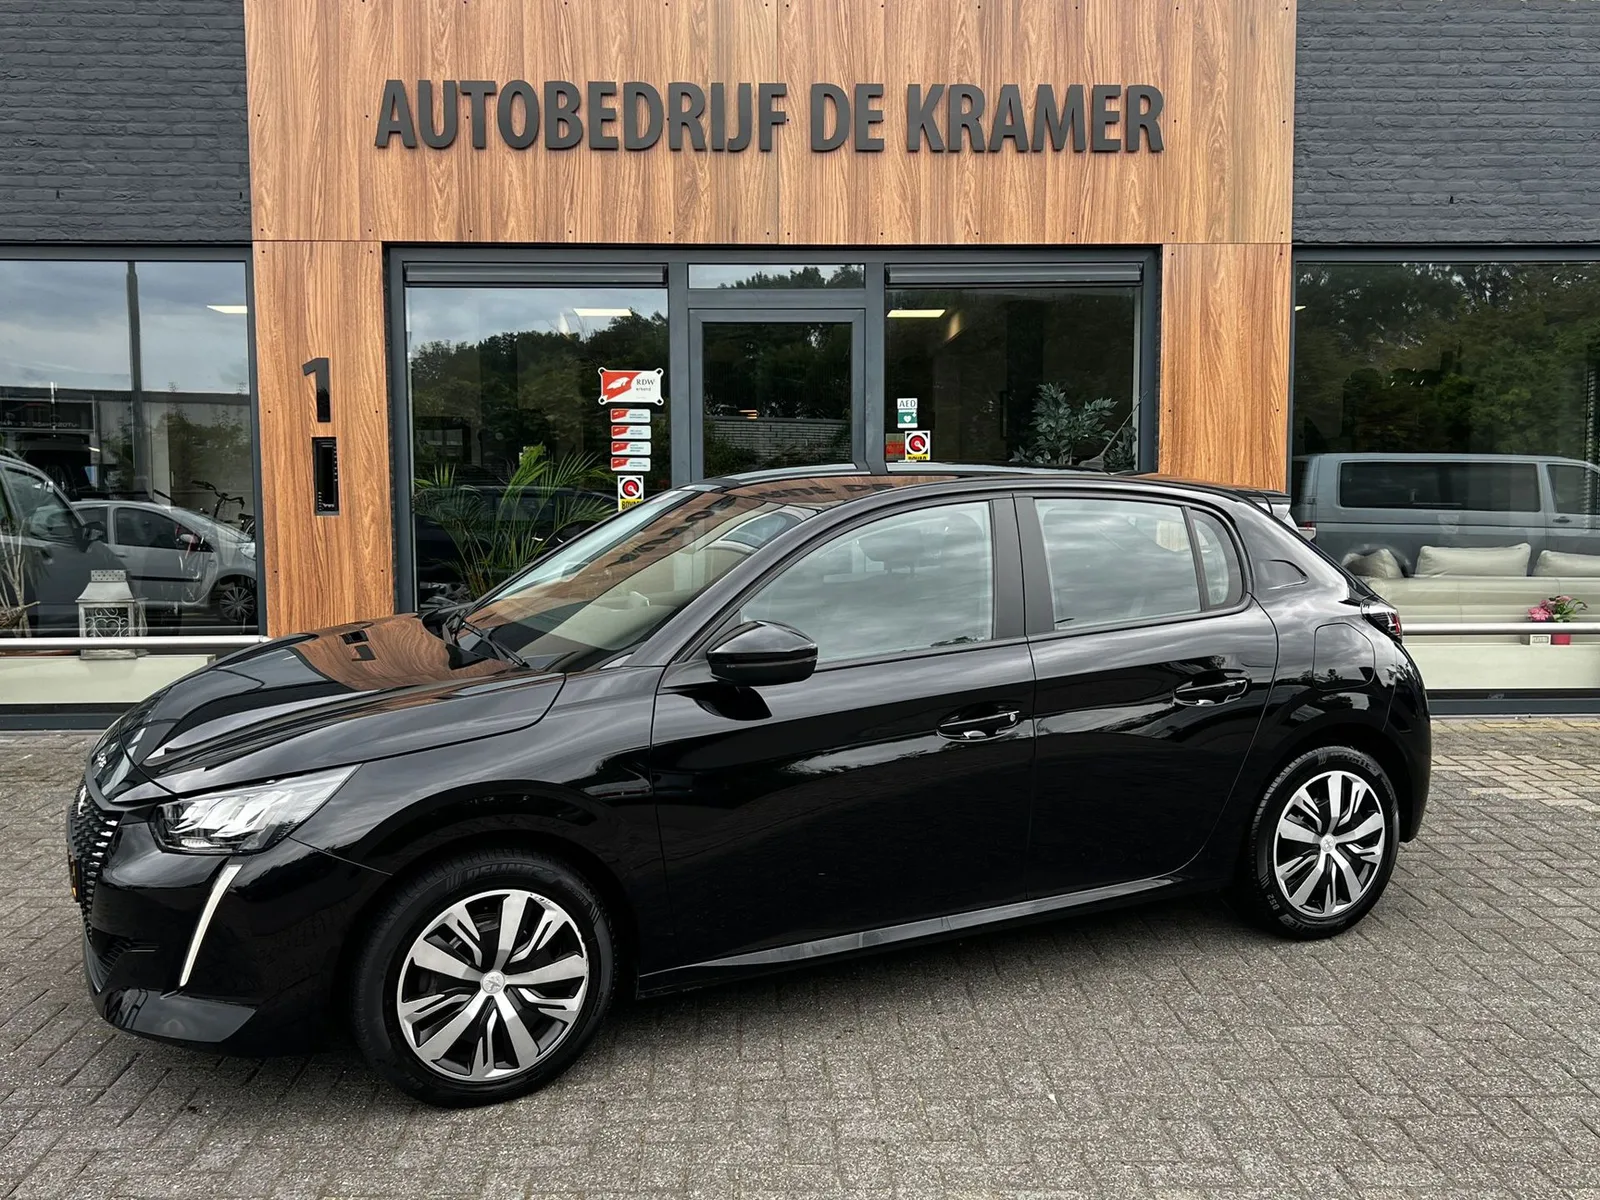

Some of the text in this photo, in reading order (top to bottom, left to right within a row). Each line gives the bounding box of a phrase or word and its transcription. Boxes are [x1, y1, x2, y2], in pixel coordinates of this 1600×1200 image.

[375, 79, 1164, 153] AUTOBEDRIJF DE KRAMER
[636, 378, 654, 386] RDW
[302, 357, 331, 423] 1
[899, 399, 916, 408] AED
[621, 500, 640, 510] BOV
